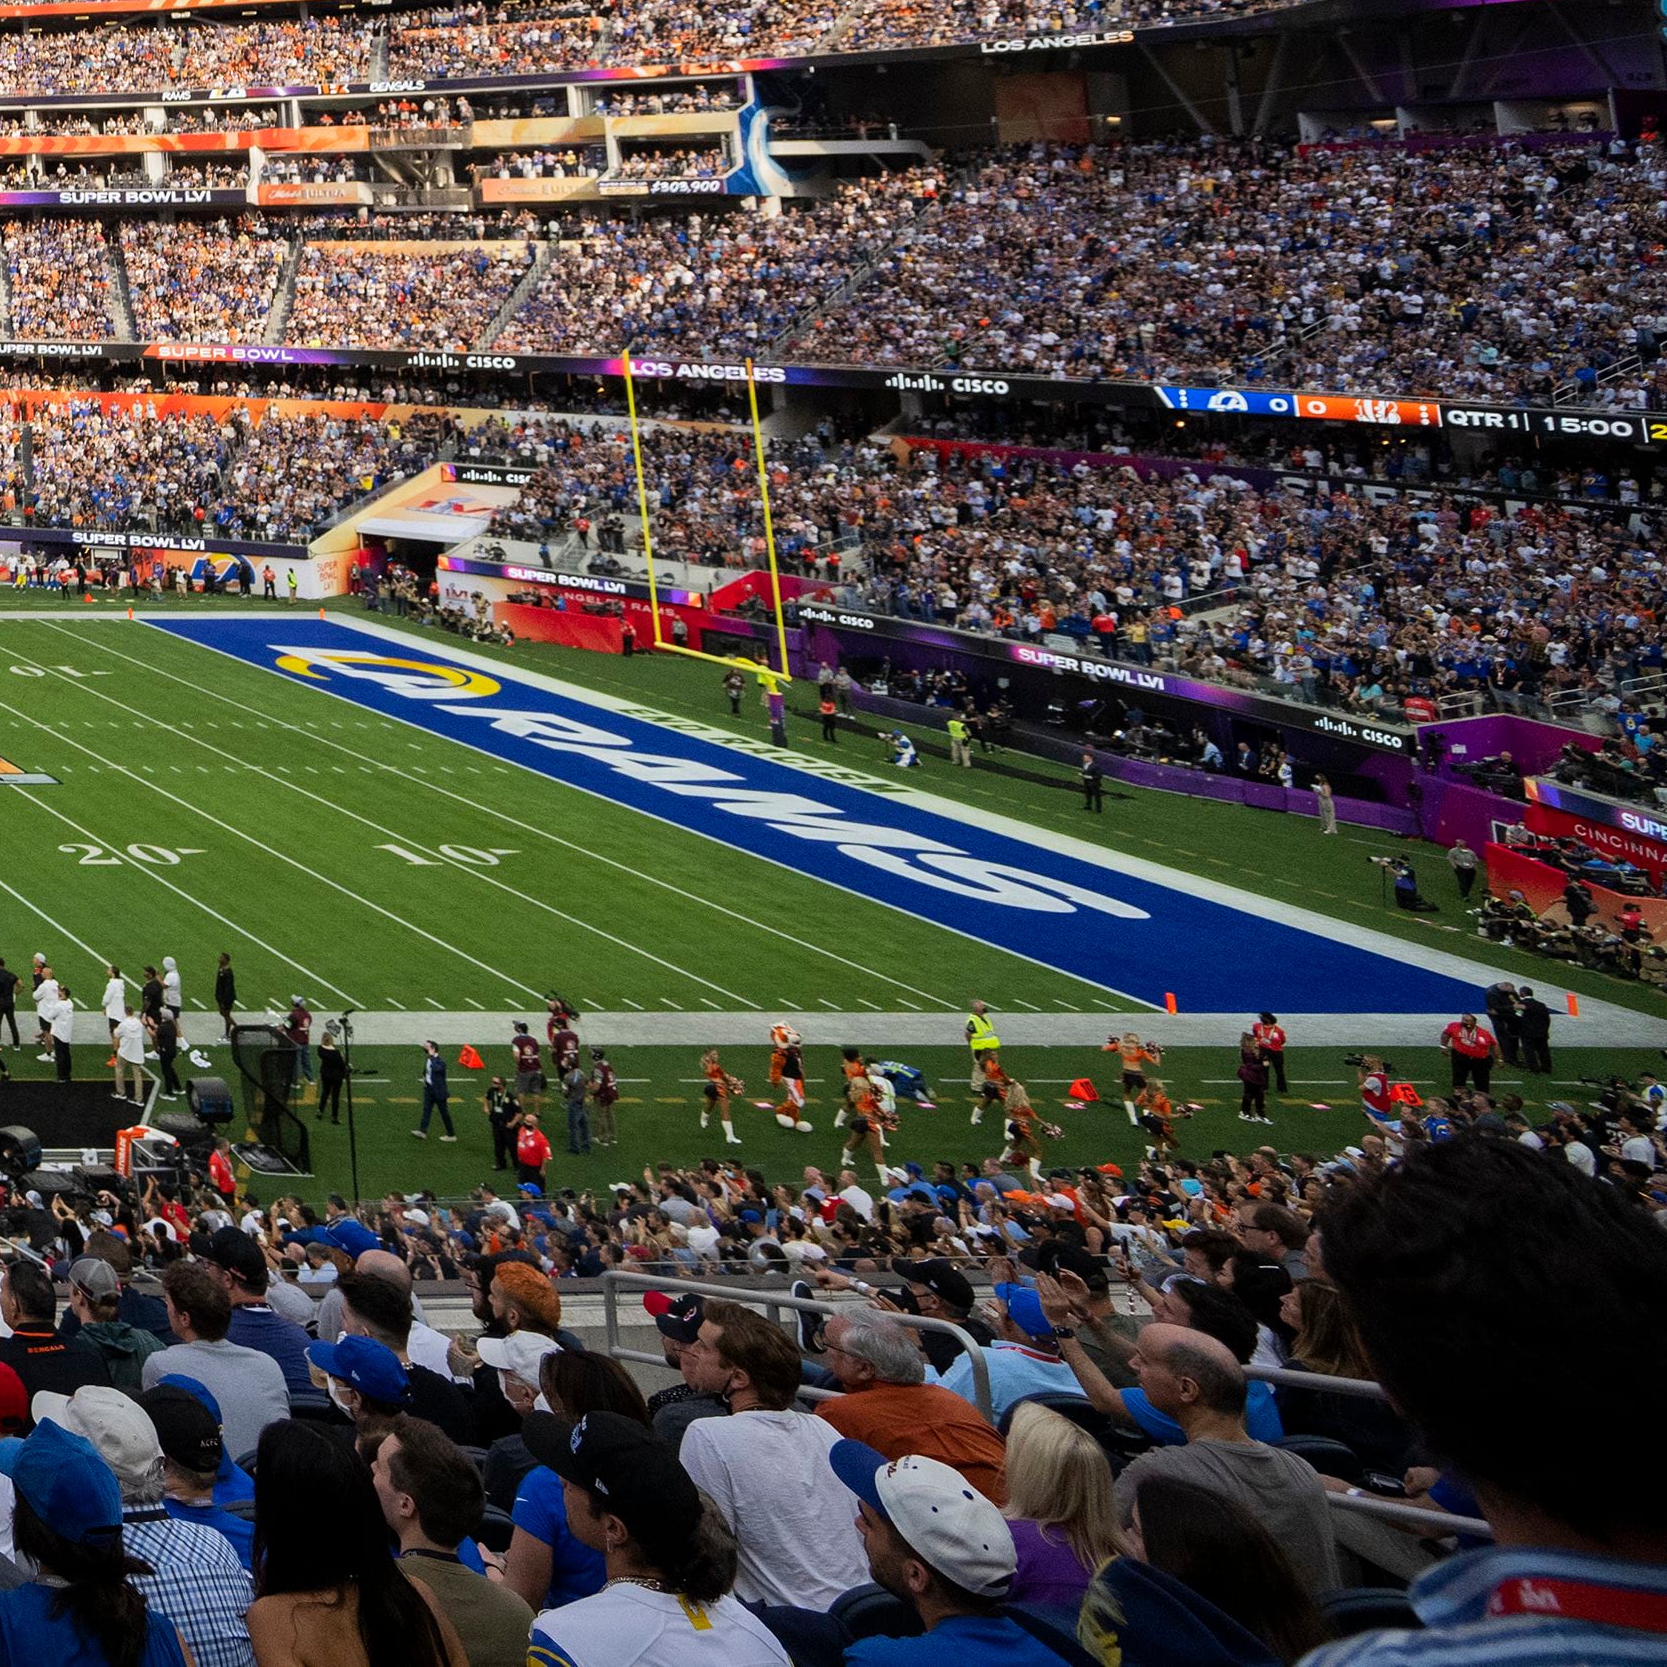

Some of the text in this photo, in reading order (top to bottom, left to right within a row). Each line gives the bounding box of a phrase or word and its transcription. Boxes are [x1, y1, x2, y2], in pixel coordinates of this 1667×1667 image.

[980, 30, 1135, 54] LOS ANGELES
[59, 189, 212, 204] SUPER BOWL LVI
[37, 343, 78, 355] BOWL
[80, 343, 104, 356] LVI
[158, 344, 294, 362] SUPER BOWL
[465, 353, 516, 370] CISCO
[951, 376, 1009, 395] CISCO
[1543, 415, 1634, 438] 15:00
[506, 565, 628, 593] SUPER BOWL LVI
[838, 614, 876, 631] CISCO
[1017, 645, 1165, 690] SUPER BOWL LVI
[1361, 726, 1403, 750] CISCO
[614, 708, 917, 794] END RACISM
[436, 705, 1152, 921] RAMS
[57, 842, 183, 867] 20
[373, 843, 503, 867] 10
